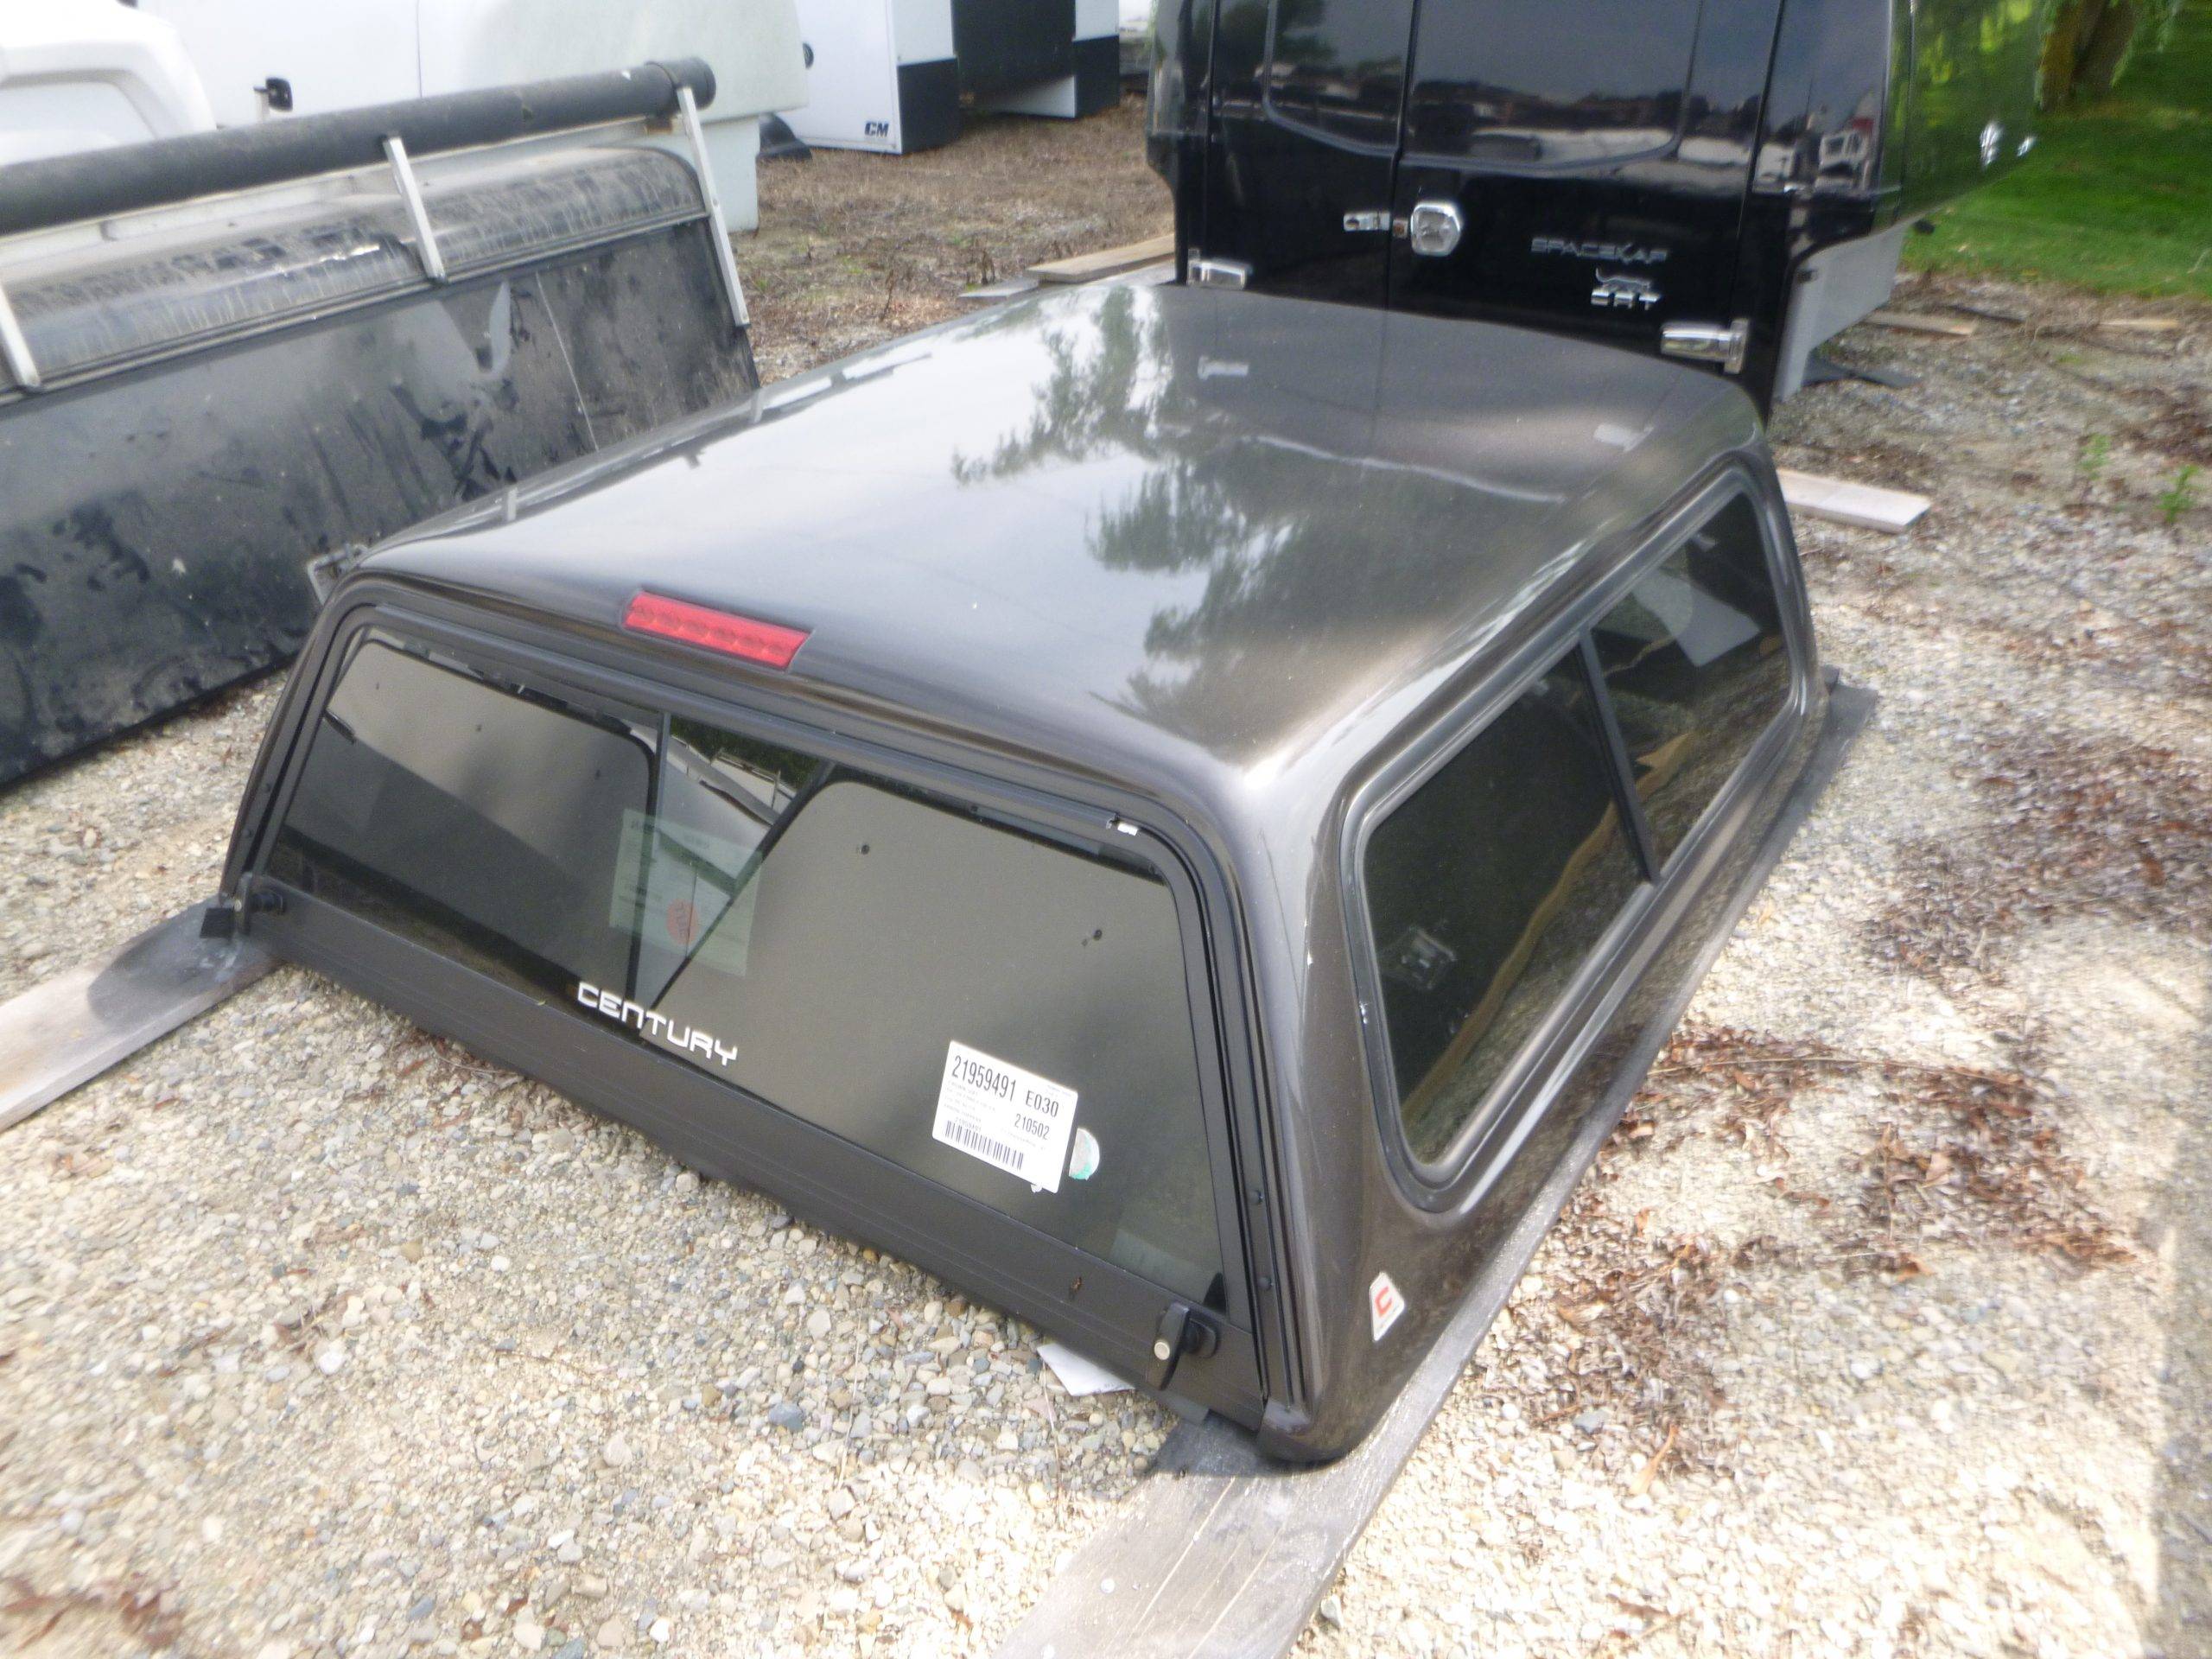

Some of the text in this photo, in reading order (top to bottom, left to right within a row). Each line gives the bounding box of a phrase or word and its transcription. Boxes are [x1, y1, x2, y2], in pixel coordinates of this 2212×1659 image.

[865, 122, 889, 137] CM
[577, 982, 738, 1066] CENTURY
[951, 1055, 1016, 1102] 21959491
[1026, 1090, 1059, 1118] E030
[1014, 1113, 1050, 1140] 210502
